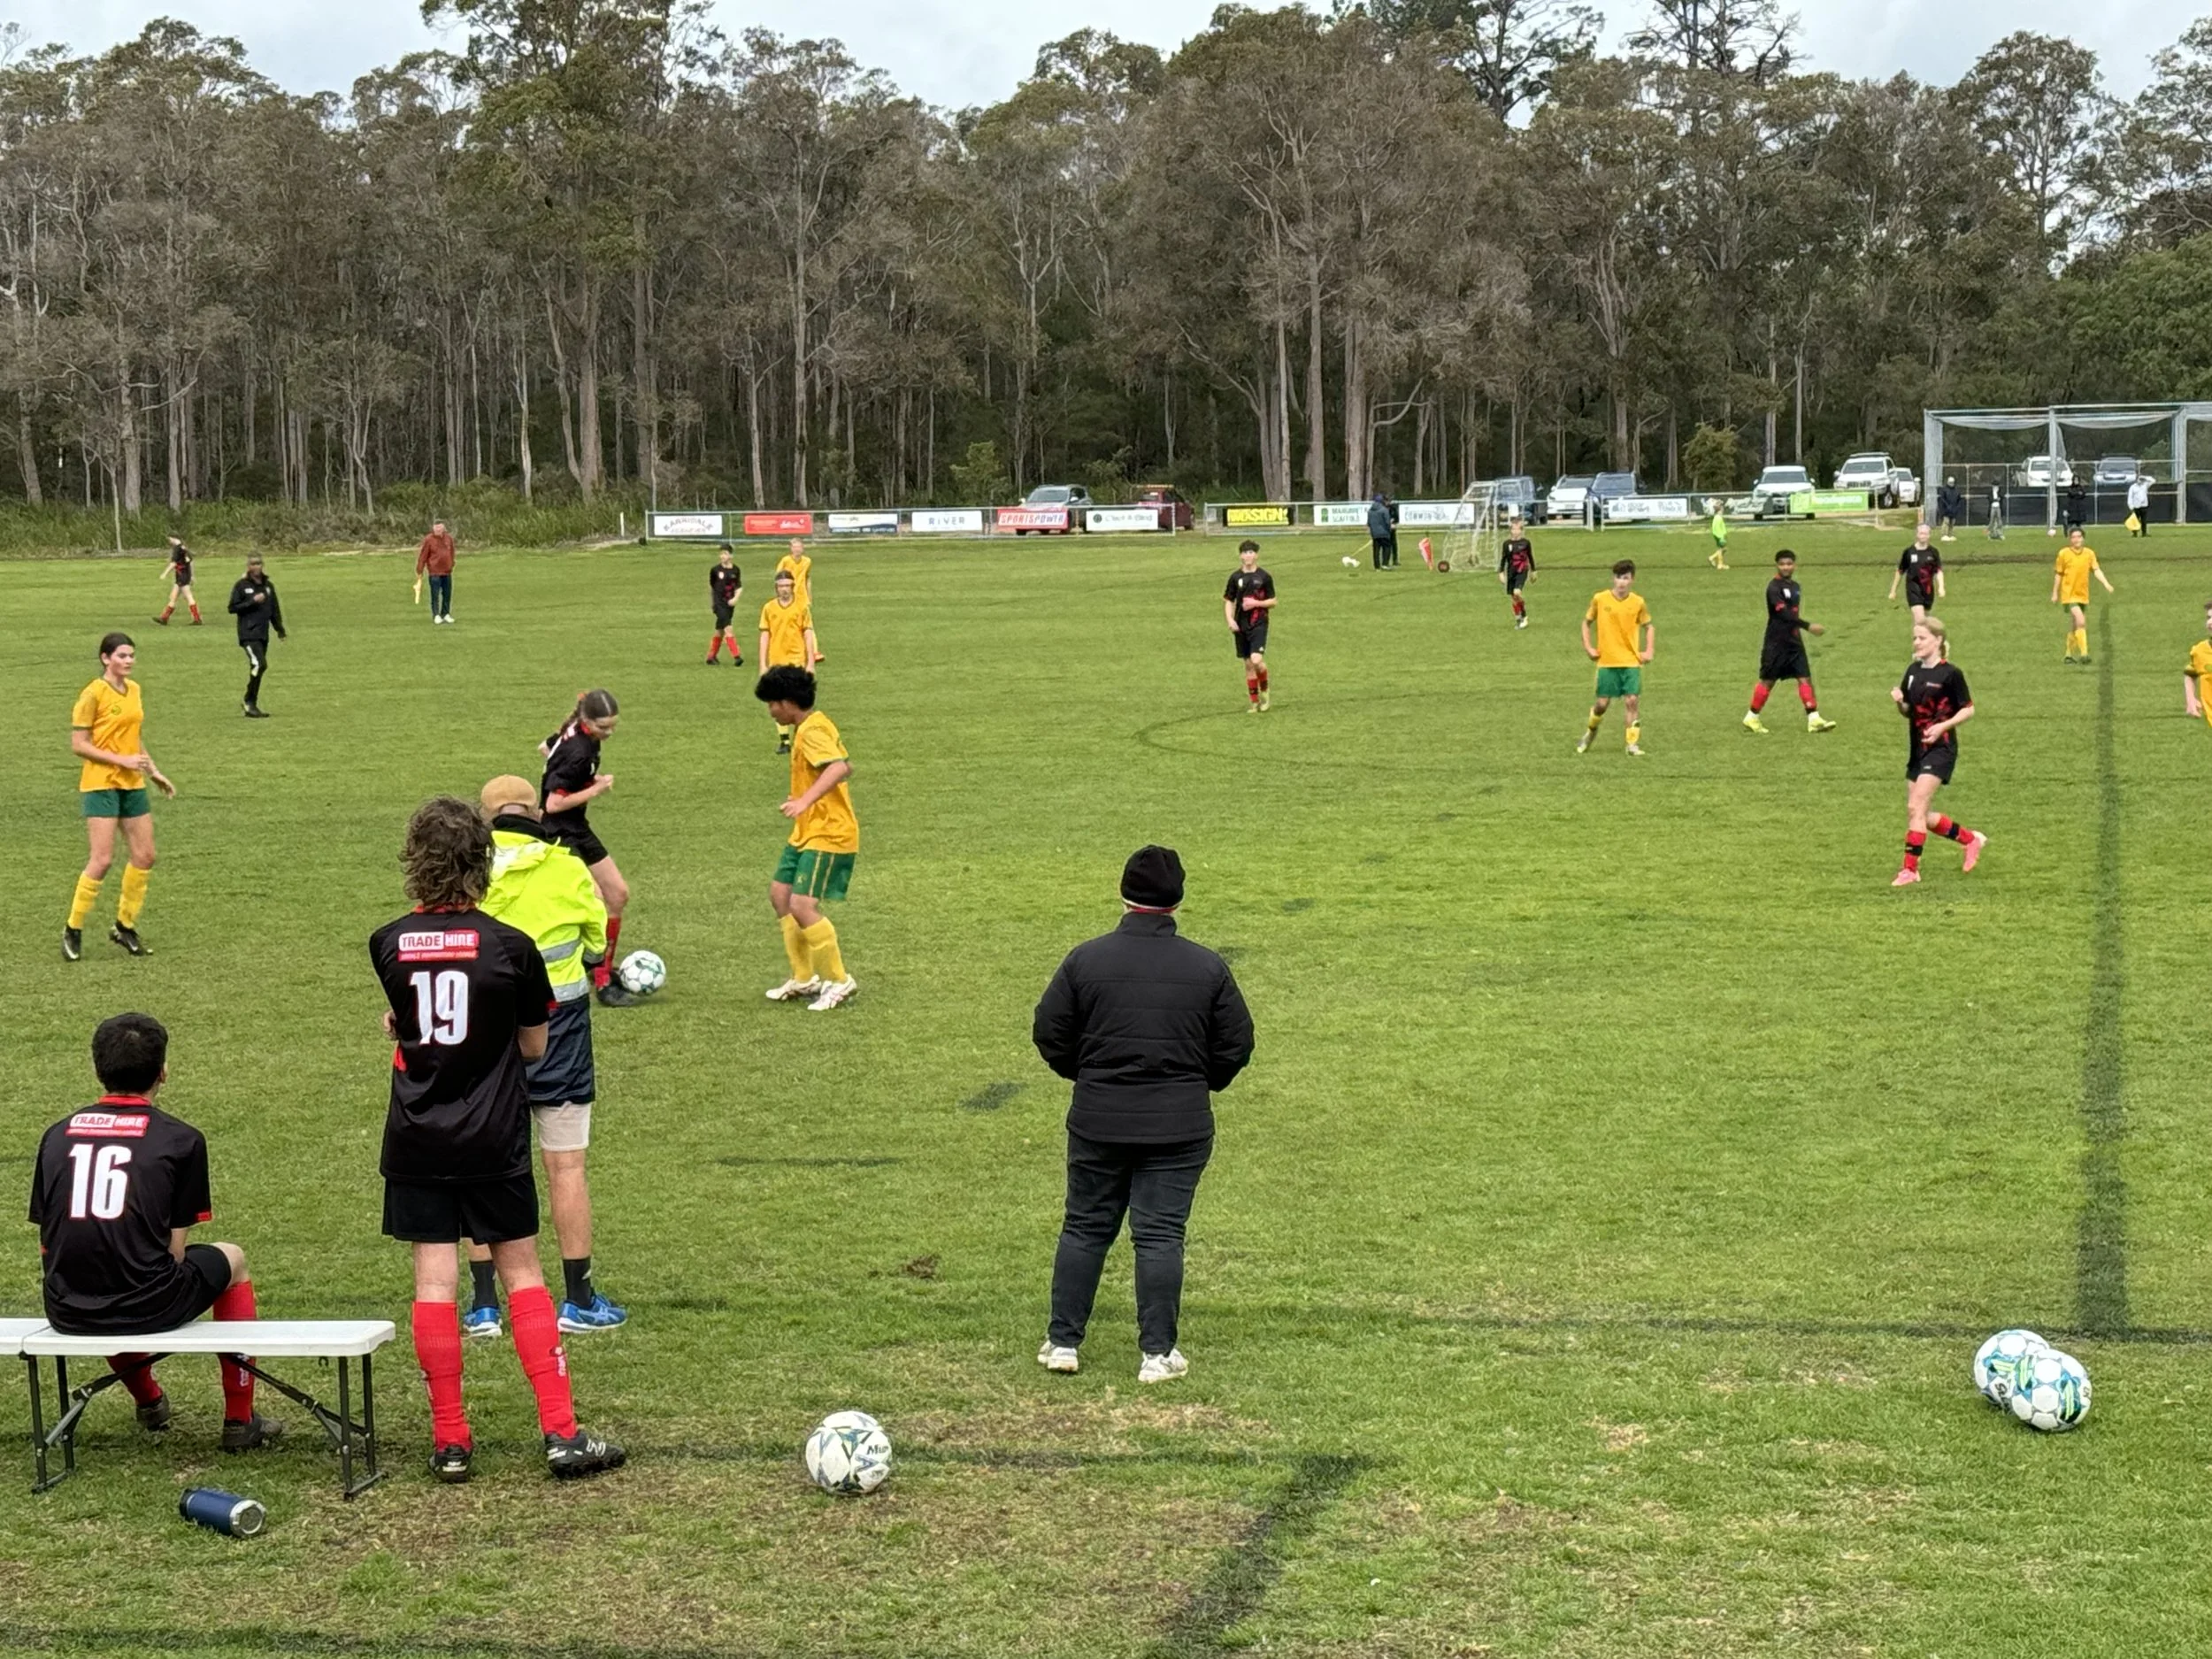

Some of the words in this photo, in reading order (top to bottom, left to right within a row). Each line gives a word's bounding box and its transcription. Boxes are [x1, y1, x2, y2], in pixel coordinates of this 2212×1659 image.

[1001, 513, 1064, 524] SPORTSPOWER
[402, 934, 442, 949] TRADE
[444, 933, 475, 947] HIRE
[410, 971, 469, 1046] 19
[73, 1115, 111, 1127] TRADE
[114, 1115, 144, 1128] HIRE
[69, 1143, 132, 1219] 16
